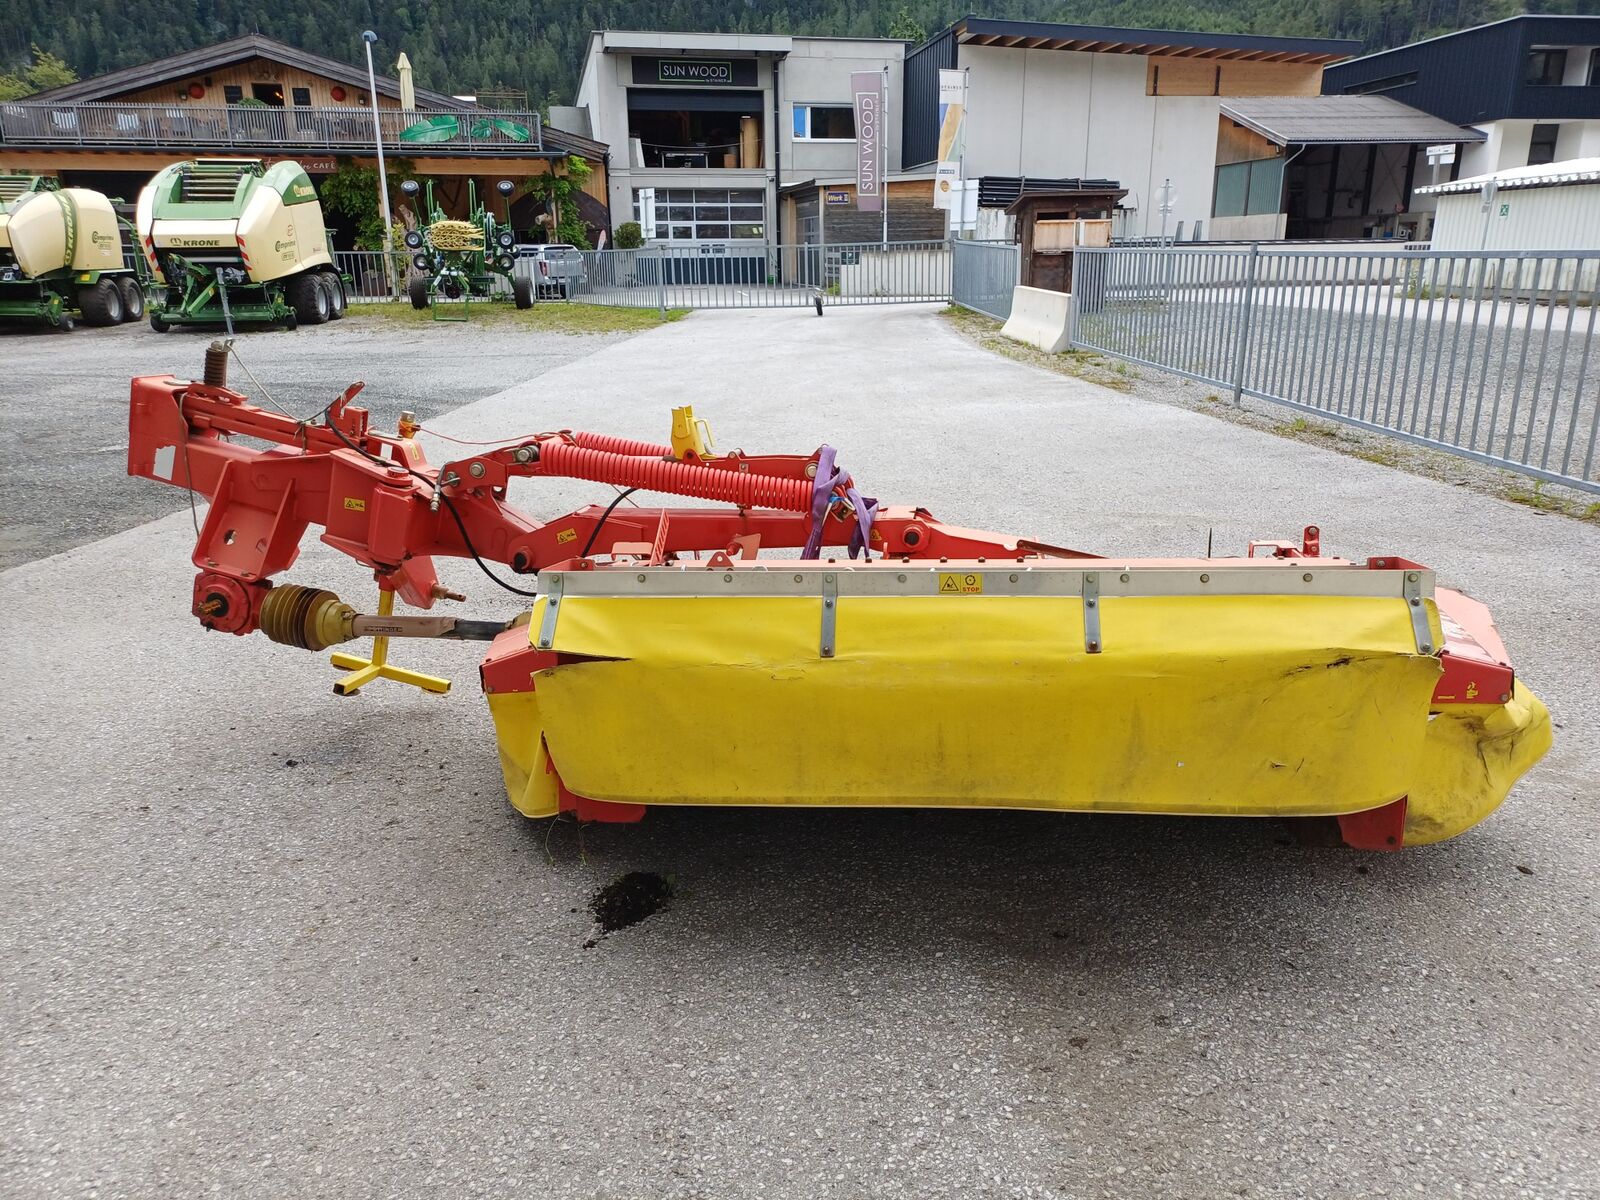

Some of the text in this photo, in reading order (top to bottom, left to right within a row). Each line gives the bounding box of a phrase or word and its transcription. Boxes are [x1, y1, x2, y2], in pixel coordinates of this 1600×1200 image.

[663, 65, 728, 78] SUN WOOD
[862, 98, 874, 190] SUN WOOD
[313, 161, 336, 170] CAFÉ
